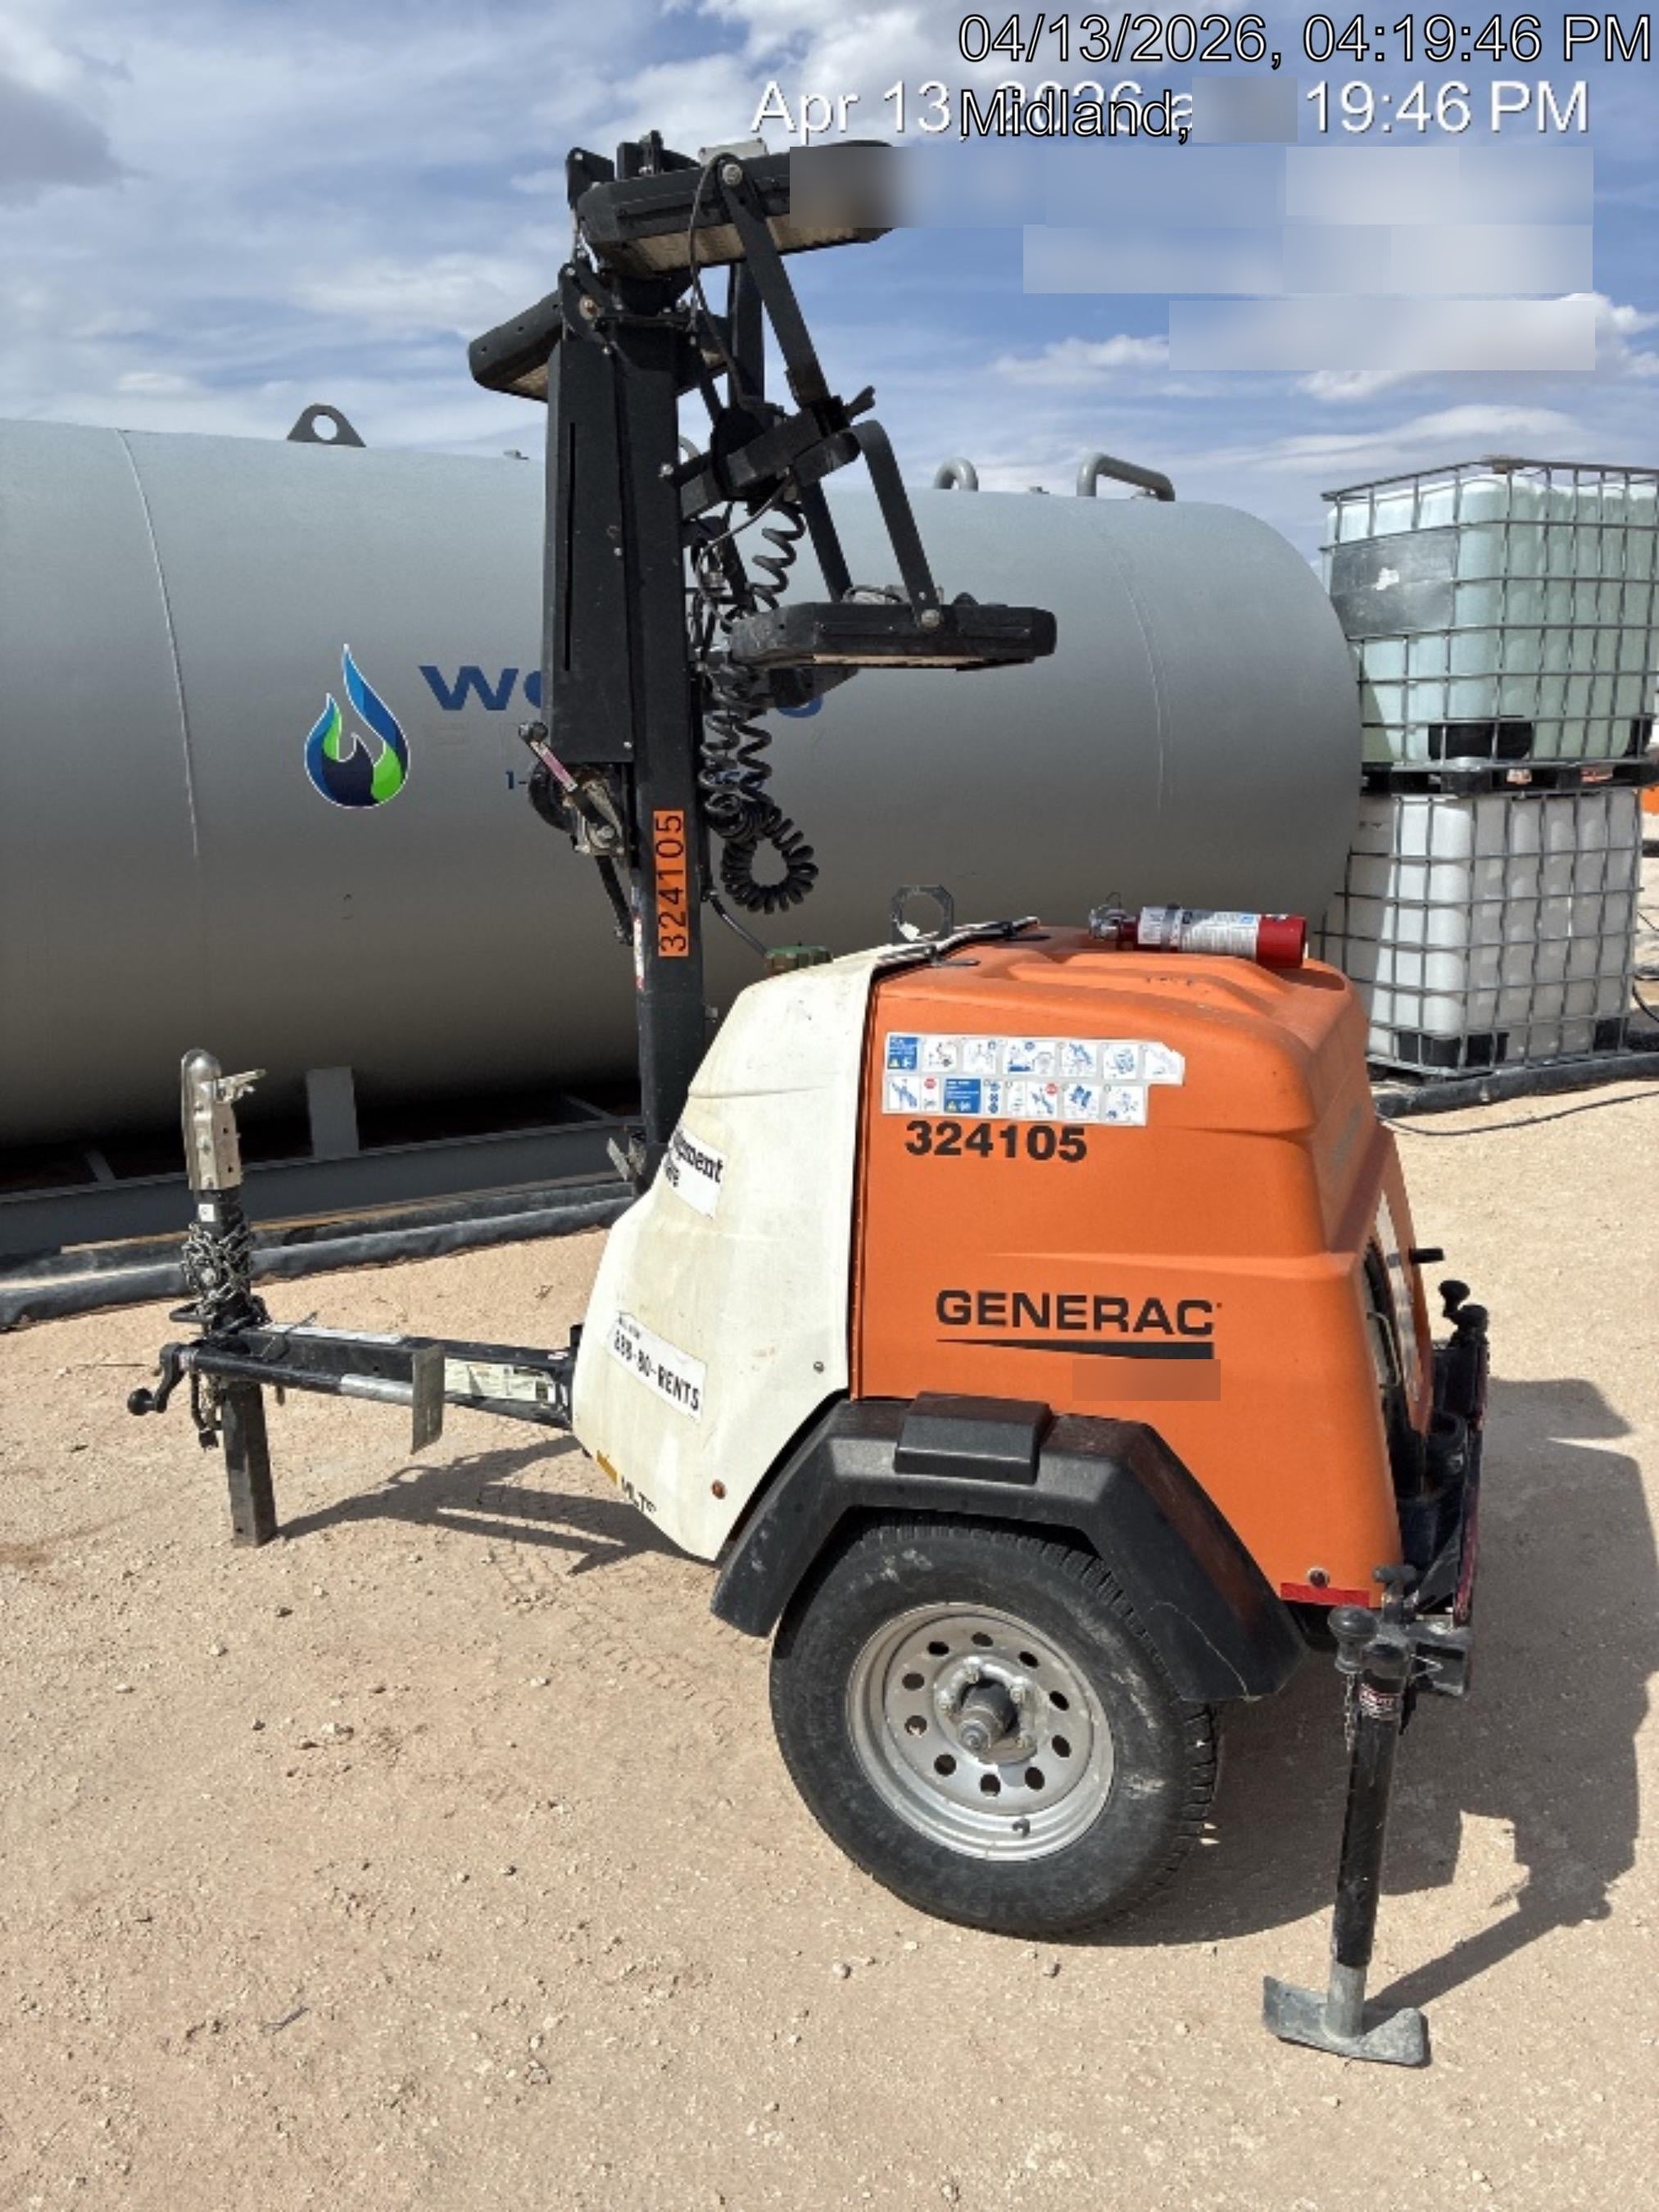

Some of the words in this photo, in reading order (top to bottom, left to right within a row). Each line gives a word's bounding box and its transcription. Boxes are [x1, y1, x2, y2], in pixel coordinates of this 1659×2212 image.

[655, 814, 687, 952] 324105
[905, 1120, 1087, 1163] 324105
[936, 1290, 1214, 1336] GENERAC
